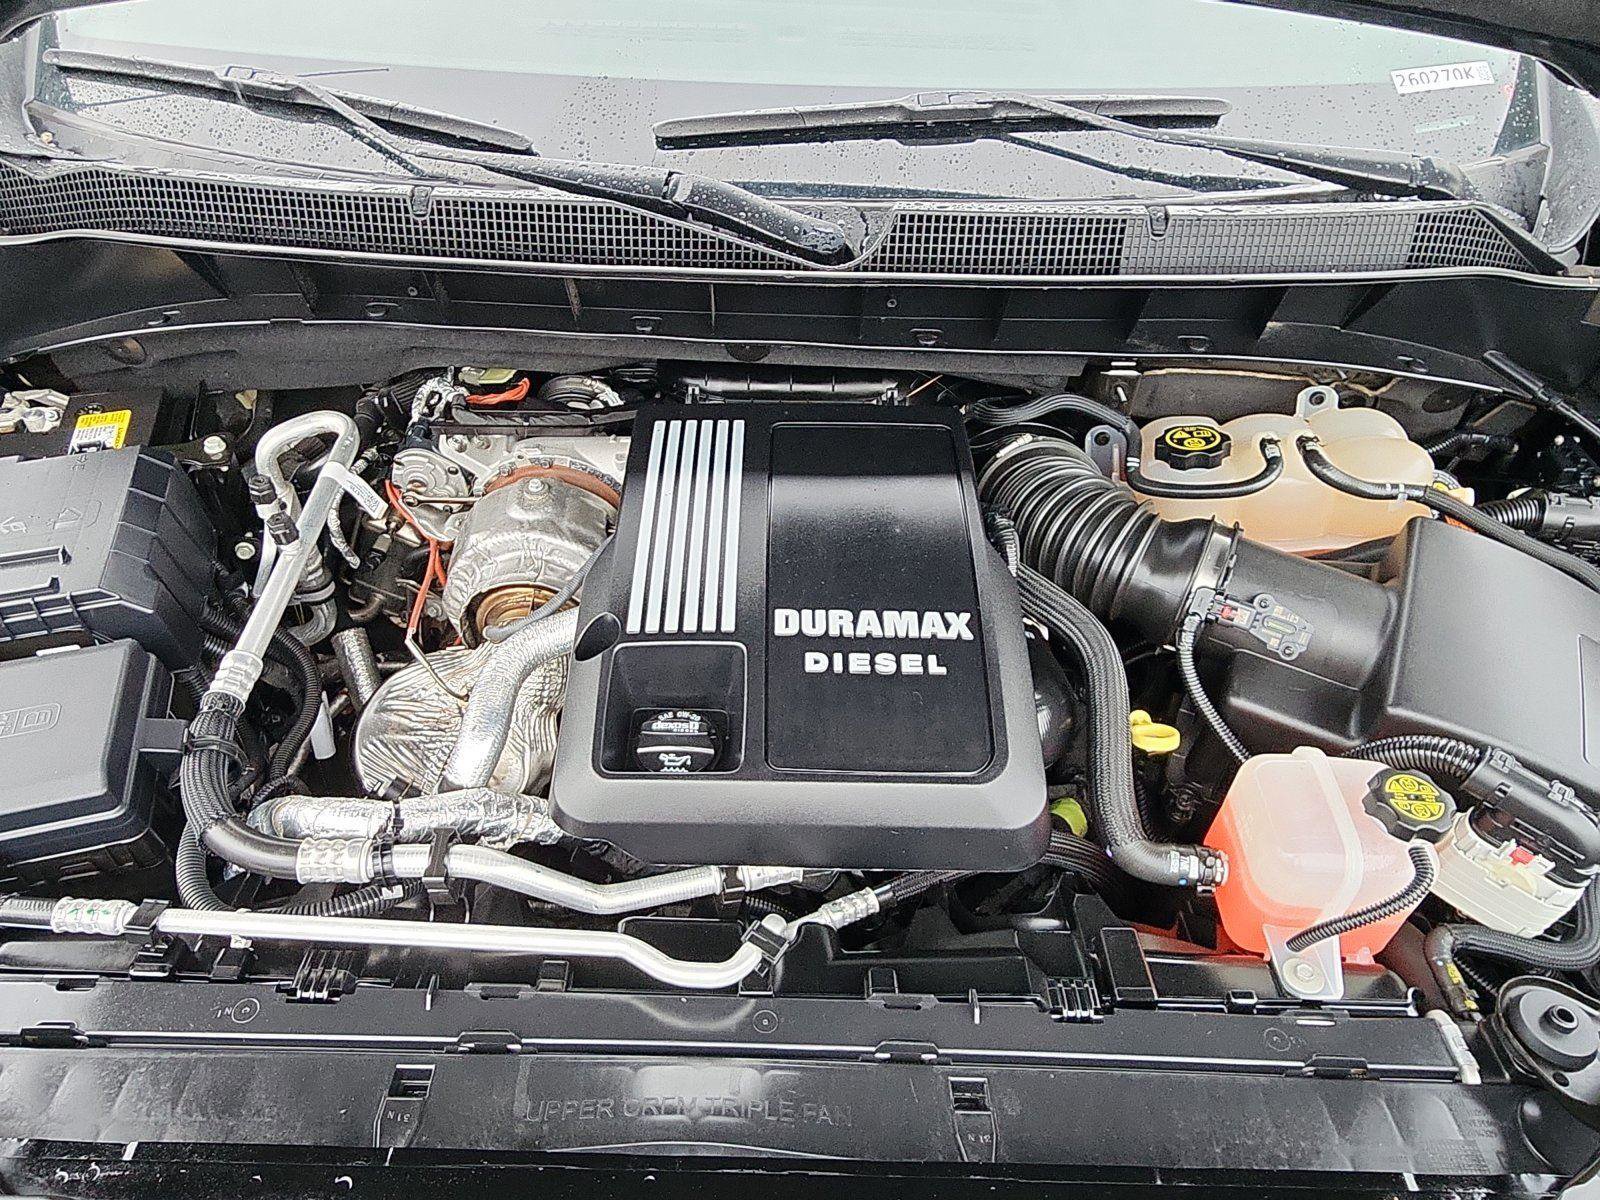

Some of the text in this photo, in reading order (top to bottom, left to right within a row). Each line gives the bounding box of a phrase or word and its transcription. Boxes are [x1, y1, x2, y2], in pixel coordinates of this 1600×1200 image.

[773, 607, 975, 641] DURAMAX
[804, 651, 948, 676] DIESEL
[525, 1098, 616, 1122] UPPER
[705, 1095, 796, 1122] TRIPLE
